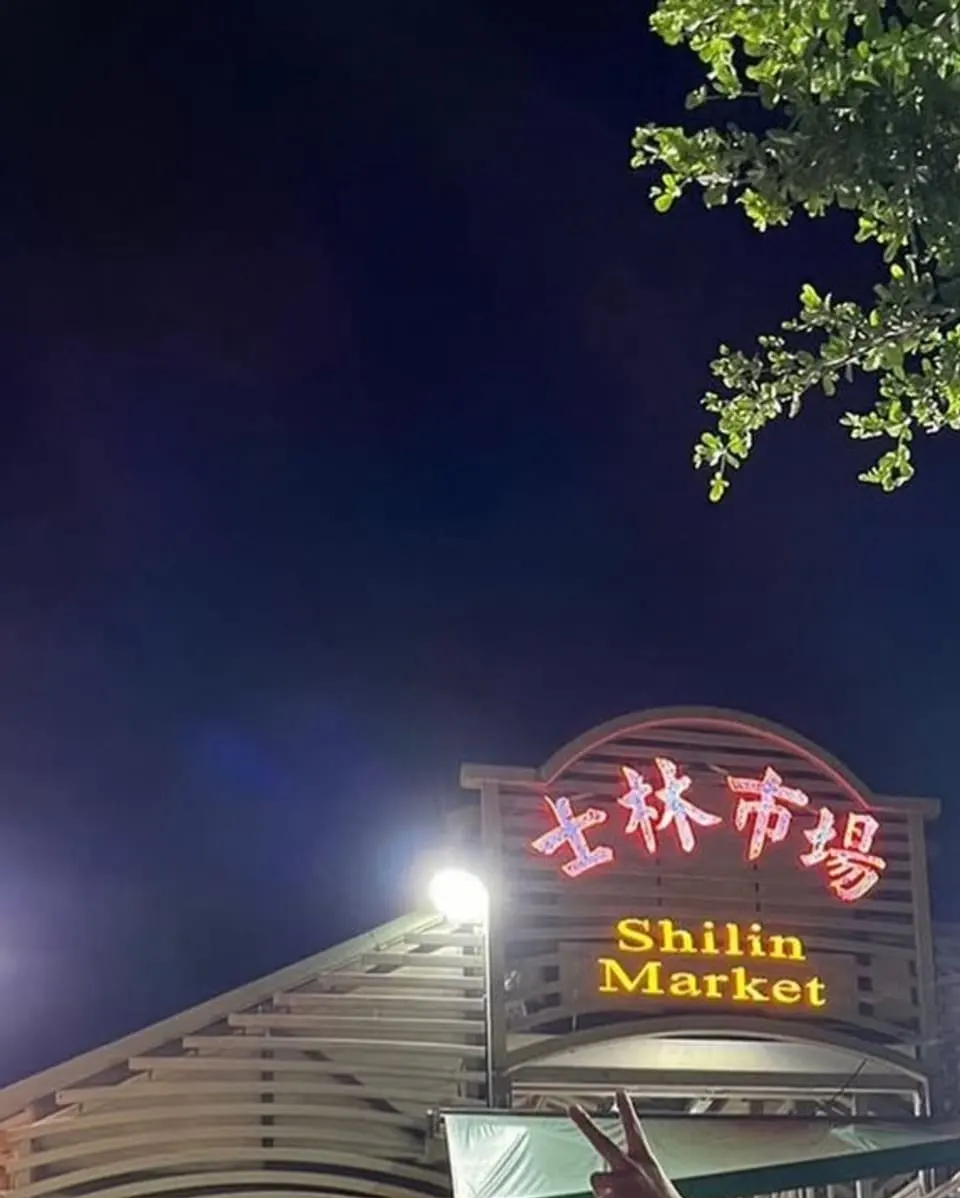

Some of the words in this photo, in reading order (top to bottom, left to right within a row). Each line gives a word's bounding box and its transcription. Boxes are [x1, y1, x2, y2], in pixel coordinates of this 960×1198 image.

[531, 757, 886, 900] 士林市場
[616, 918, 806, 961] Shilin
[599, 958, 827, 1007] Market
